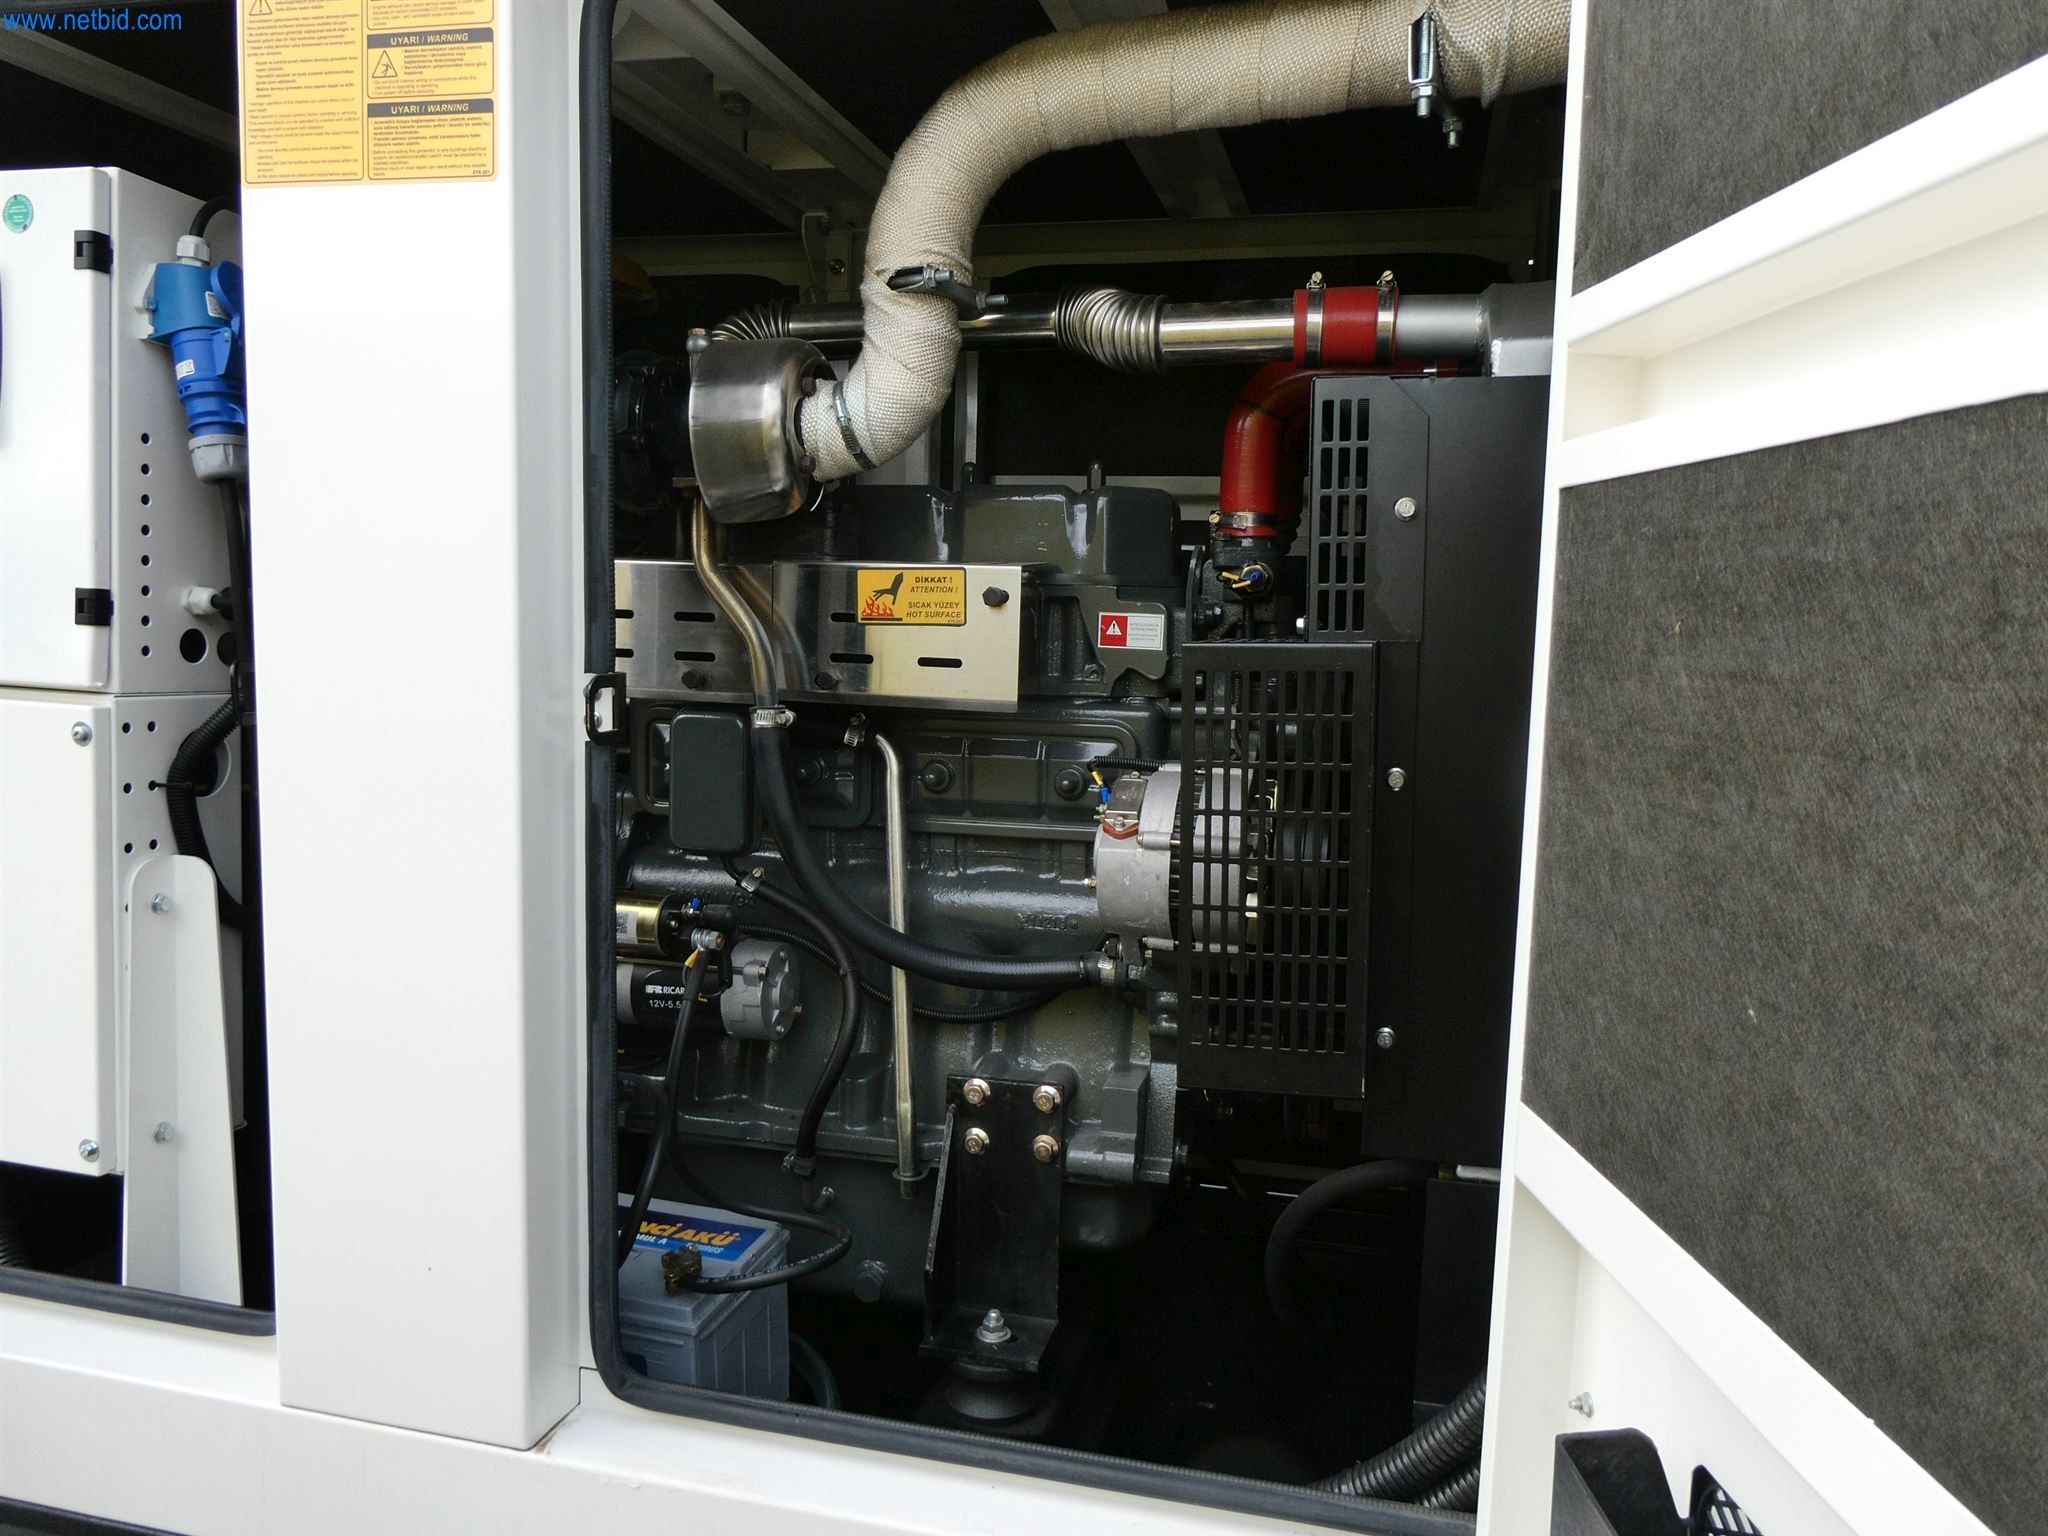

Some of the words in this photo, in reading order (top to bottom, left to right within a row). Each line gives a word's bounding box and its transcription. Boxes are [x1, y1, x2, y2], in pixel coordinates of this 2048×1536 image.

[390, 35, 420, 46] UYARI
[427, 32, 469, 44] WARNING
[390, 105, 420, 115] UYARI
[427, 103, 469, 113] WARNING
[915, 575, 948, 584] DİKKAT
[910, 585, 954, 594] ATTENTION
[908, 601, 932, 609] SICAK
[933, 599, 960, 609] YÜZEY
[906, 611, 923, 619] HOT
[924, 611, 962, 619] SURFACE
